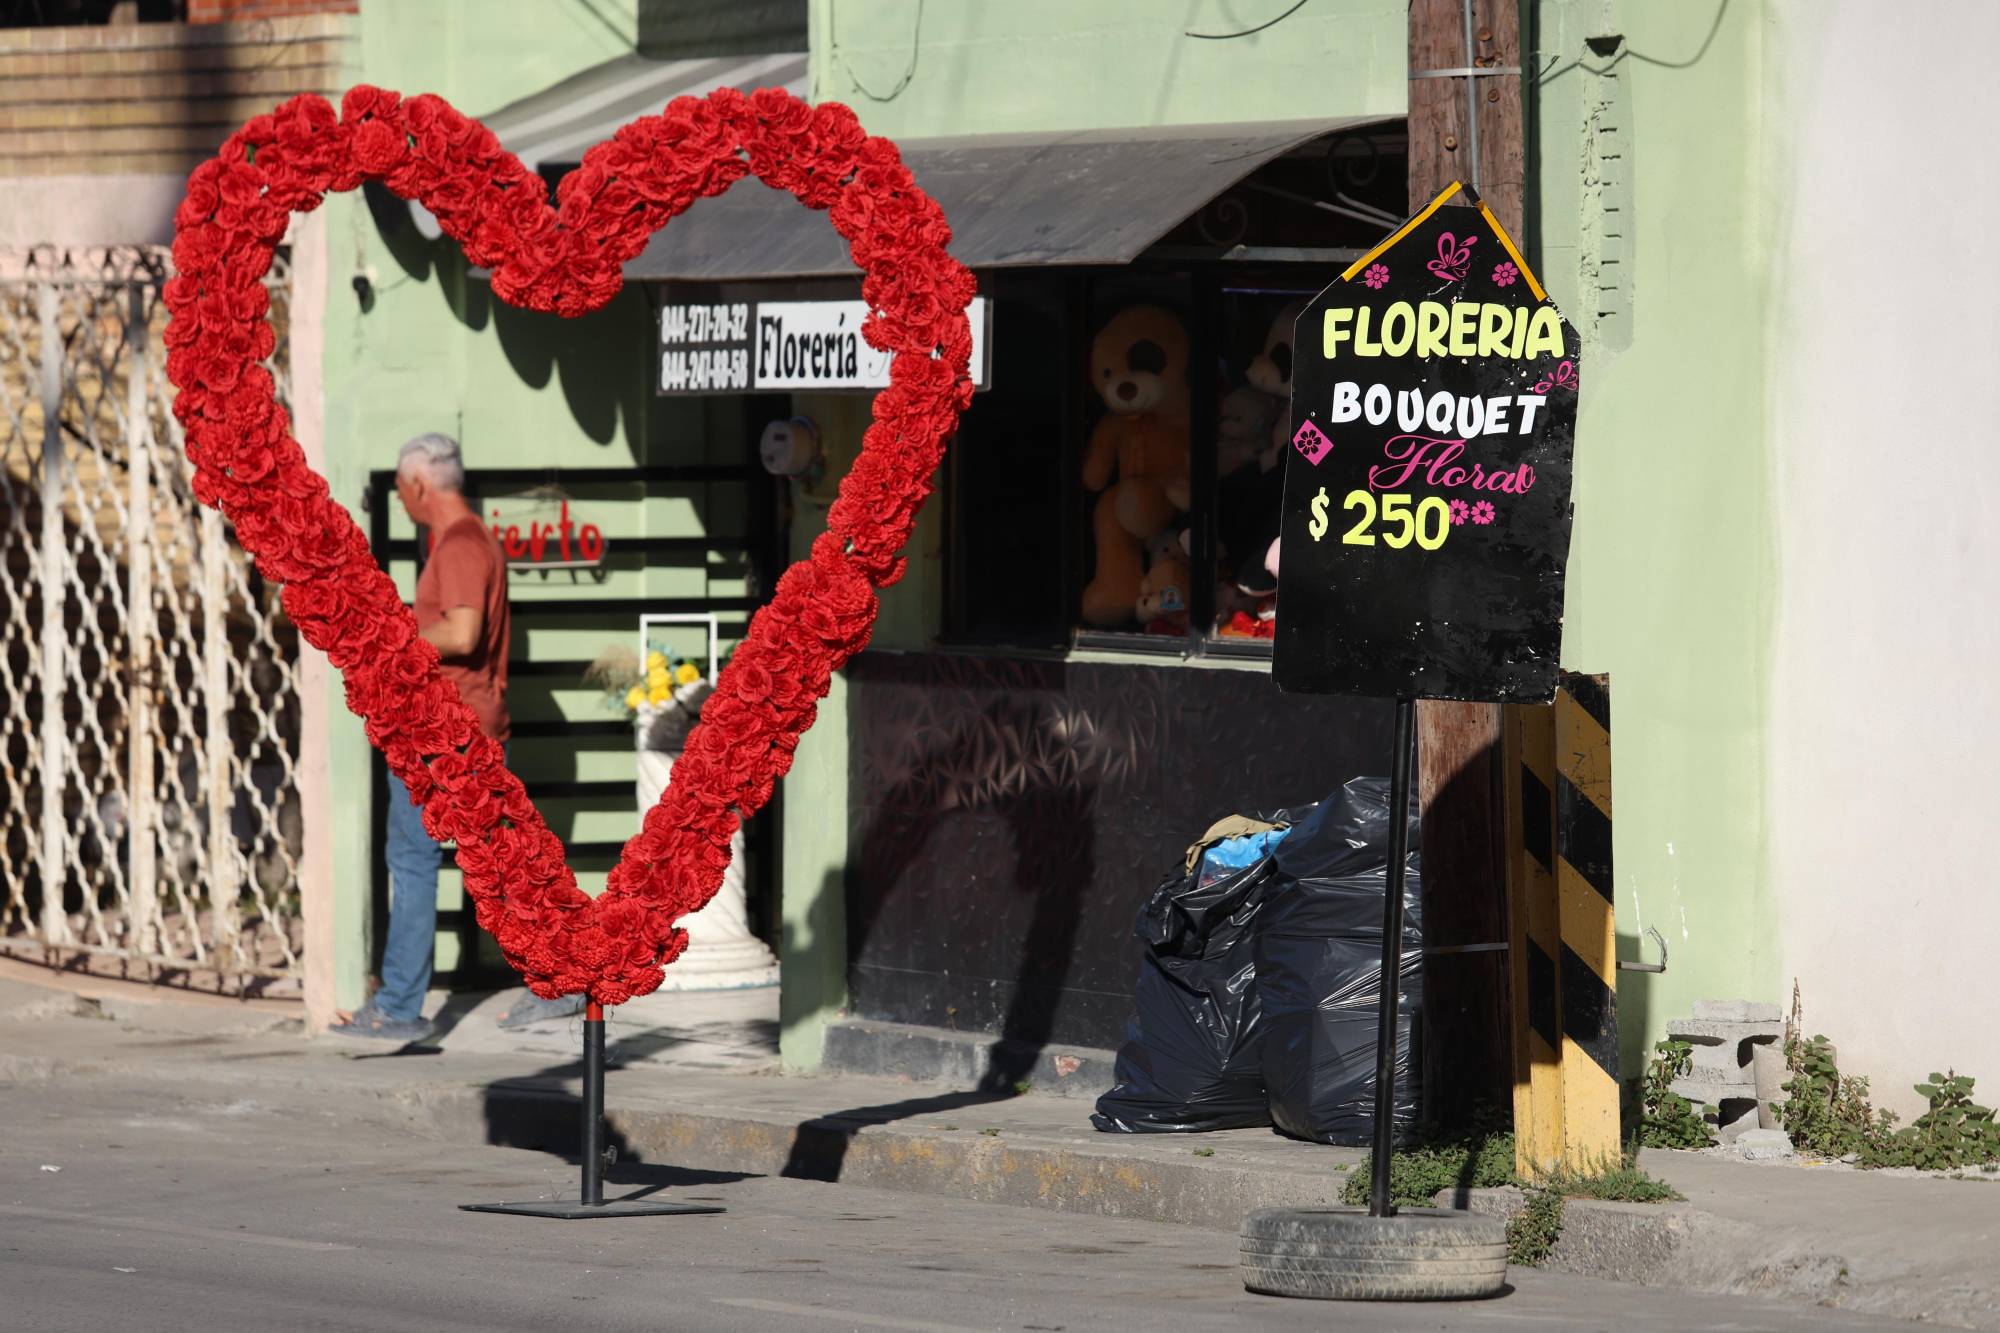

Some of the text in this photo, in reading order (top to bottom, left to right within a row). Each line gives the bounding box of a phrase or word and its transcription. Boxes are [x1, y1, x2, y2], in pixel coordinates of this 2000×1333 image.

[758, 313, 858, 379] Florería
[1323, 301, 1564, 360] FLORERIA
[1331, 381, 1546, 439] BOUQUET
[1368, 434, 1536, 495] Floral
[428, 497, 603, 564] ierto
[1309, 487, 1450, 550] $ 250
